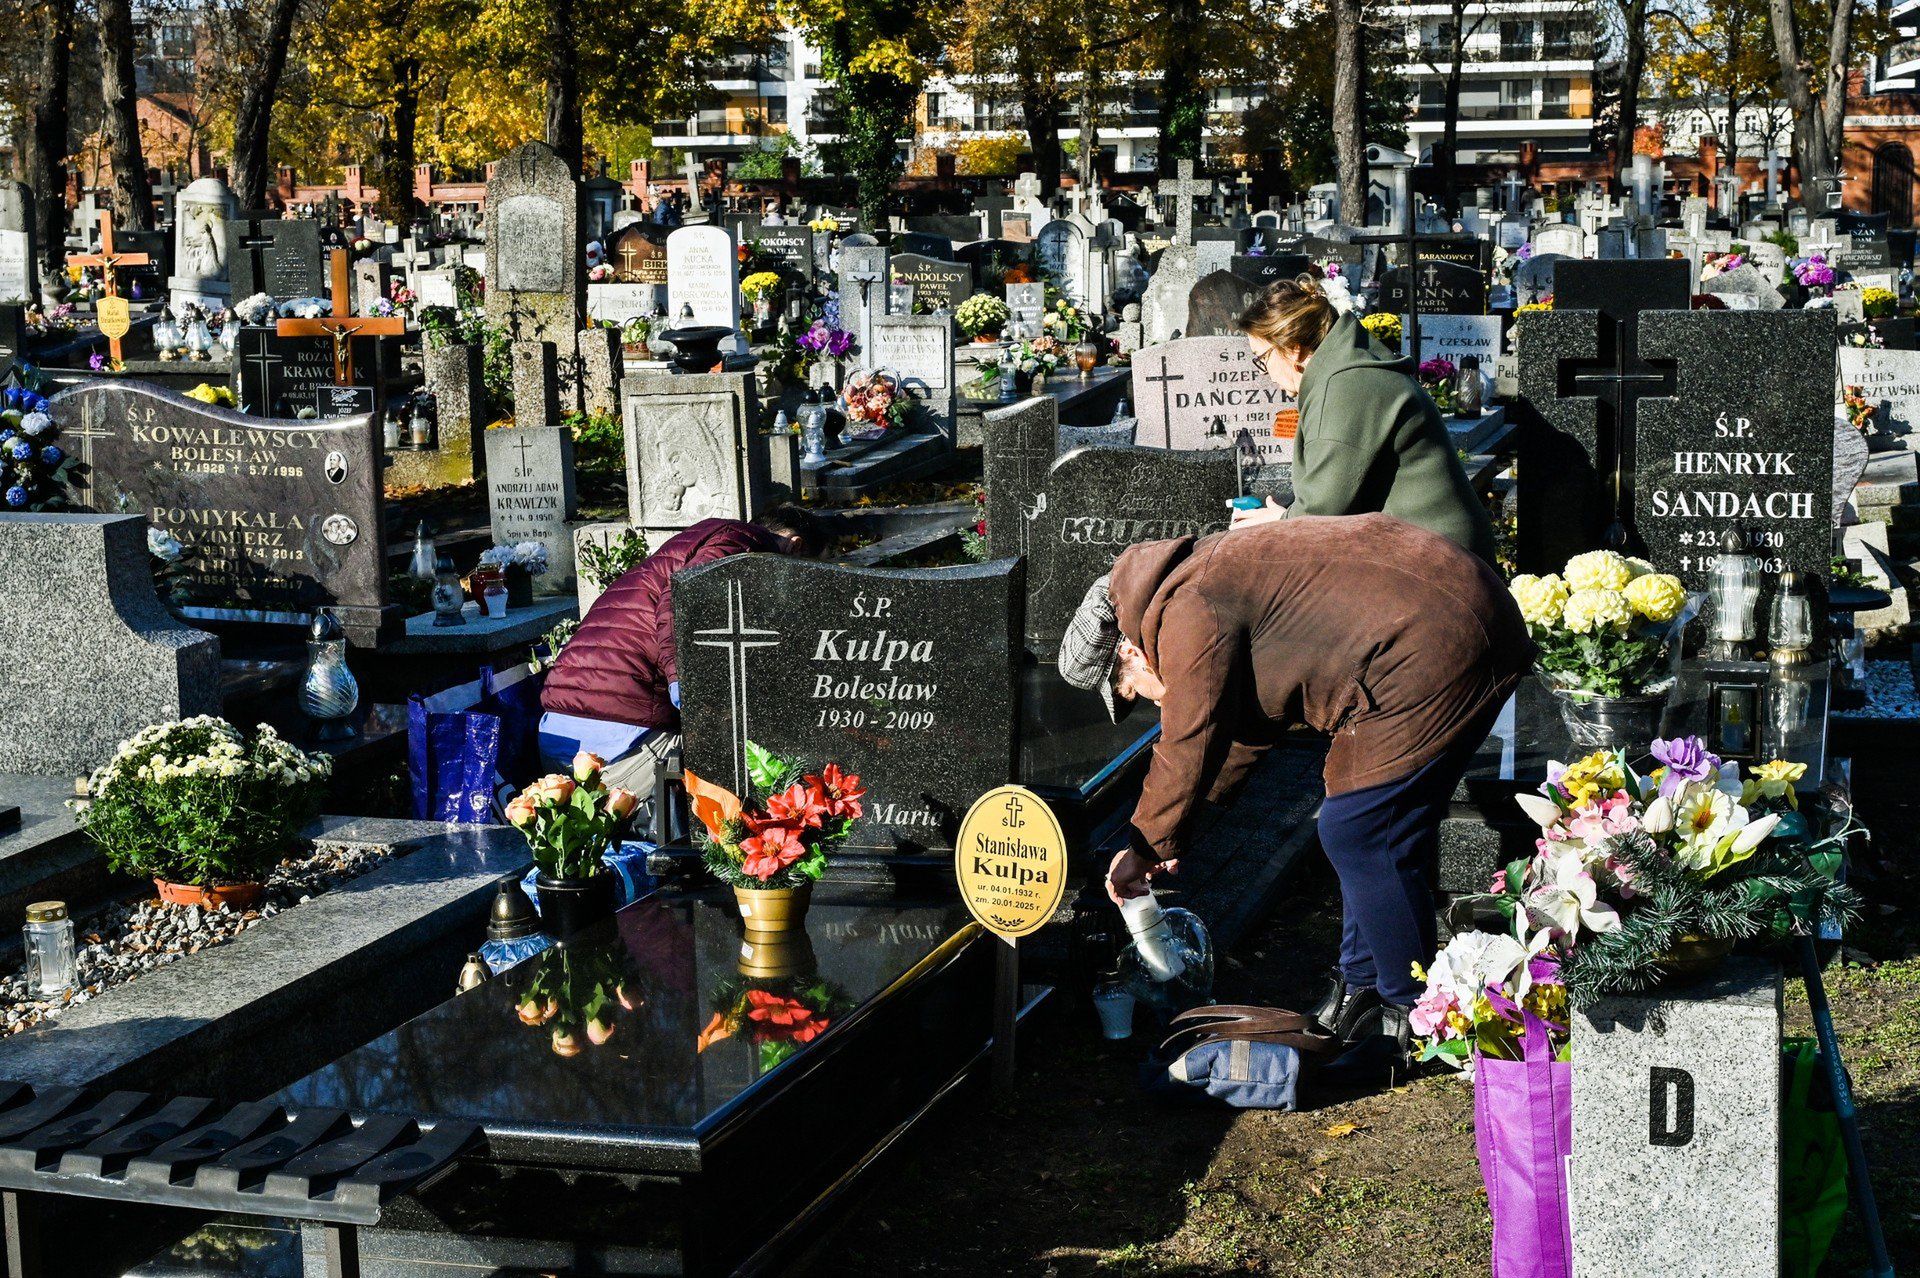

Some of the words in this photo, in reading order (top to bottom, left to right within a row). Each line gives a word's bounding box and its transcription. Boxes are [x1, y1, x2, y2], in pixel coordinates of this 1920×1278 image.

[1419, 253, 1475, 261] BARANOWSCY
[904, 273, 964, 282] NADOLSCY
[1439, 338, 1492, 347] CZESŁAW
[283, 366, 365, 379] KRAWCK
[1208, 369, 1260, 384] JÓZEF
[1854, 372, 1895, 383] FELIKS
[1175, 388, 1296, 409] DAŃCZYK
[1715, 411, 1754, 438] Ś.P.
[132, 425, 324, 449] KOWALEWSCY
[171, 446, 280, 464] BOLESŁAW
[1673, 451, 1796, 476] HENRYK
[173, 462, 226, 474] 1.7.1928
[249, 465, 303, 477] 5.7.1996
[495, 483, 533, 493] ANDRZEJ
[535, 482, 559, 492] ADAM
[497, 496, 558, 510] KRAWCZYK
[1651, 490, 1815, 519] SANDACH
[152, 507, 304, 530] POMYKAŁA
[168, 528, 284, 547] KAZIMIERZ
[850, 591, 892, 618] Ś.P.
[810, 629, 934, 672] Kulpa
[812, 674, 938, 701] Bolesław
[817, 709, 865, 729] 1930
[884, 711, 935, 730] 2009
[869, 802, 944, 827] Maria
[975, 832, 1047, 861] Stanisława
[972, 856, 1049, 886] Kulpa
[990, 884, 1033, 898] 04.01.1932
[991, 897, 1035, 911] 20.01.2025
[1650, 1066, 1695, 1147] D
